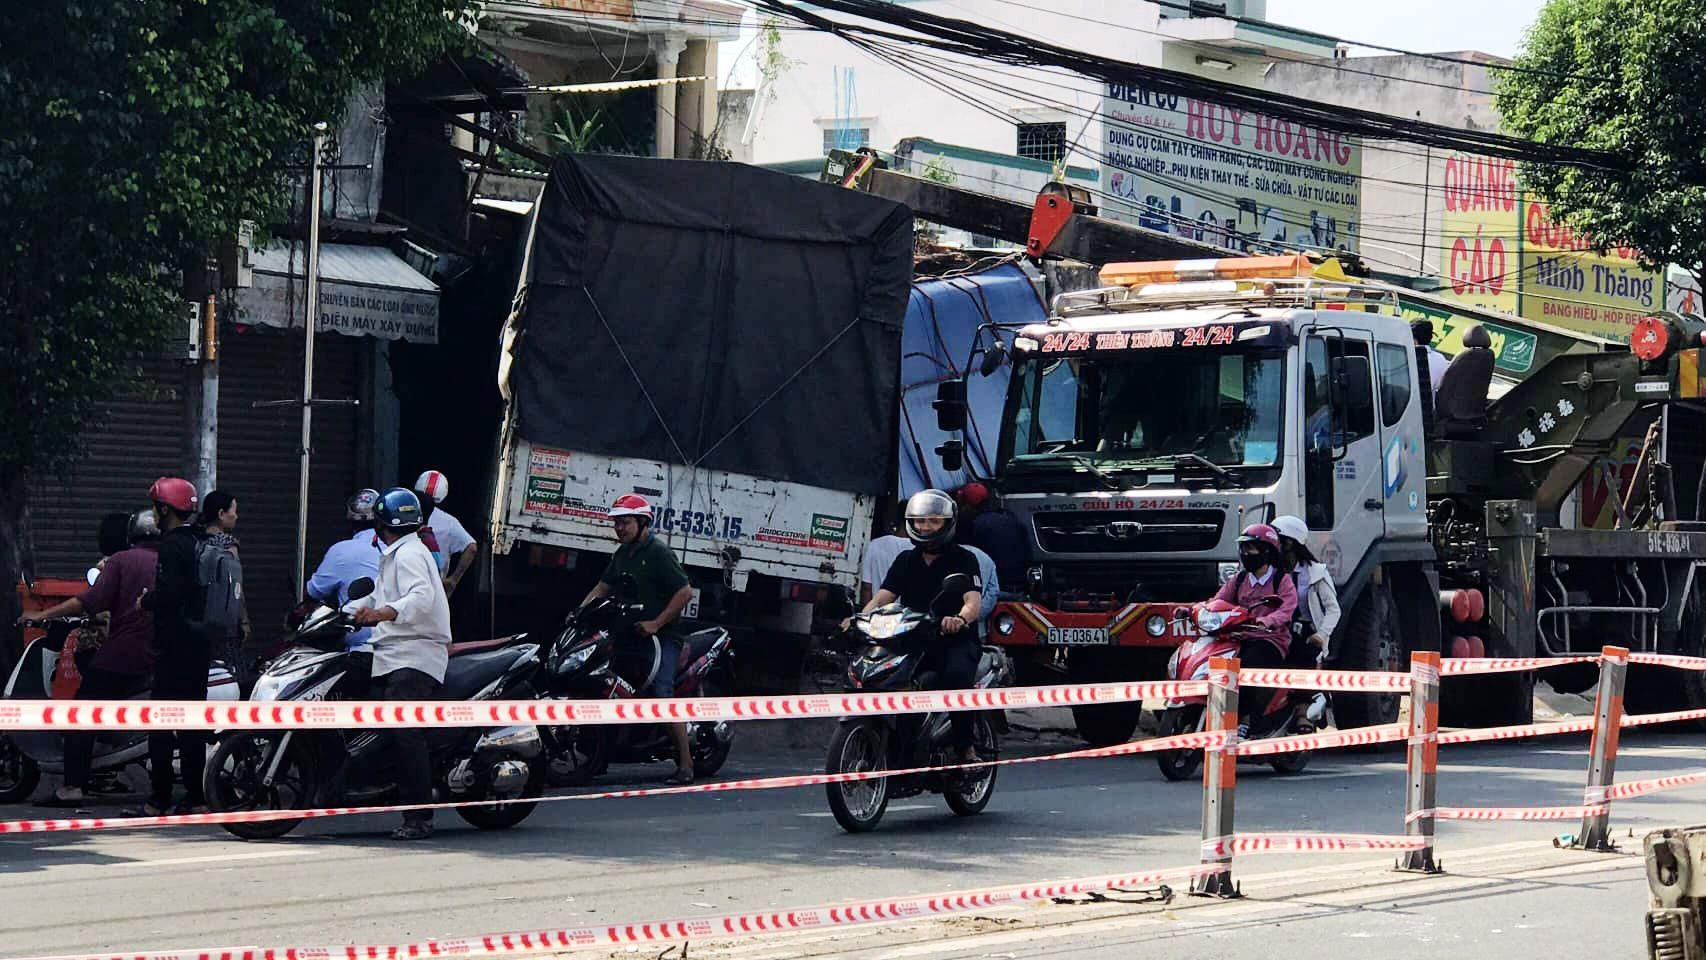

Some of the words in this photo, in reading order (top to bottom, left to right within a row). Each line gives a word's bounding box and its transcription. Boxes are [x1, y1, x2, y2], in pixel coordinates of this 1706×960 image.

[1186, 97, 1243, 146] HUY
[1211, 168, 1233, 185] THAY
[1450, 224, 1506, 296] CÁO
[1536, 256, 1586, 292] Minh
[1042, 334, 1090, 352] 24/24
[1183, 326, 1234, 347] 24/24
[1140, 499, 1184, 508] 24/24
